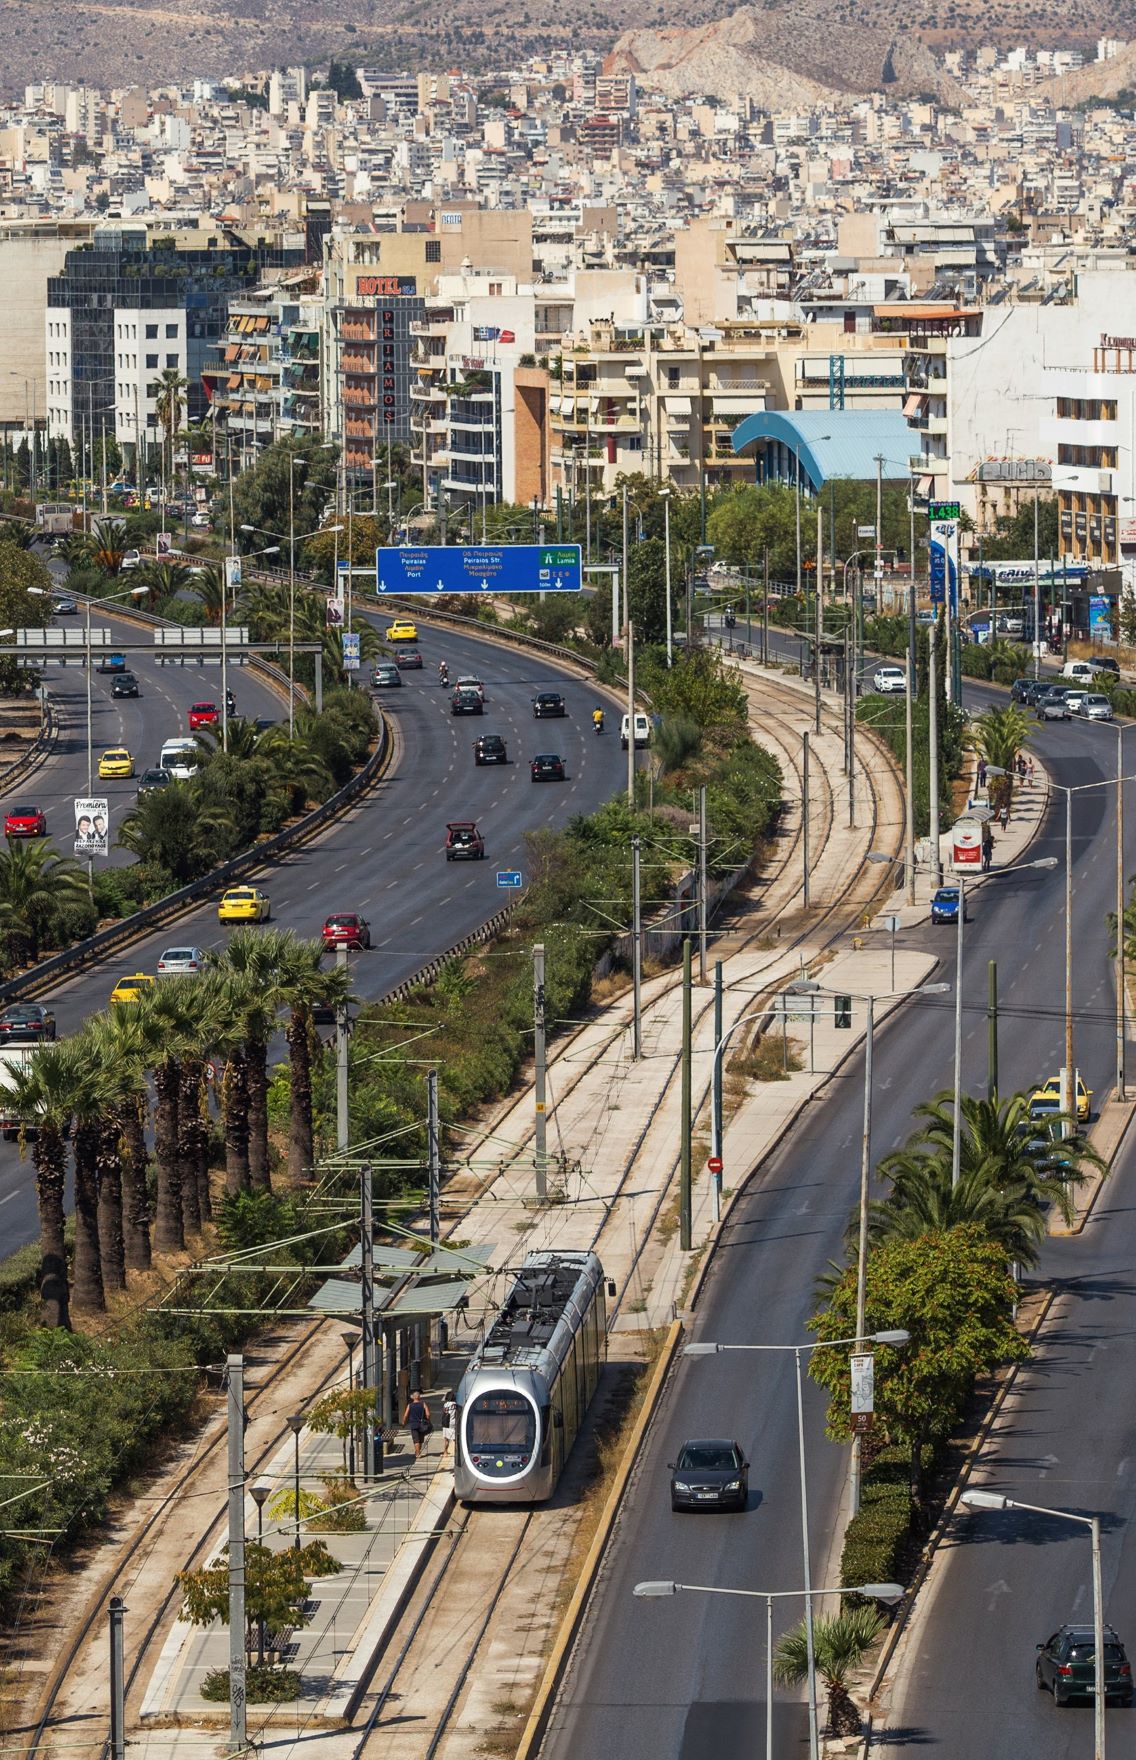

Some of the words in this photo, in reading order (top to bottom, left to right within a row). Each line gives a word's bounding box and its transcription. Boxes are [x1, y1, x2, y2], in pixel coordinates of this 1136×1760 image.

[358, 277, 400, 295] HOTEL
[383, 312, 393, 420] PRIAMOS
[929, 507, 959, 519] 1.438
